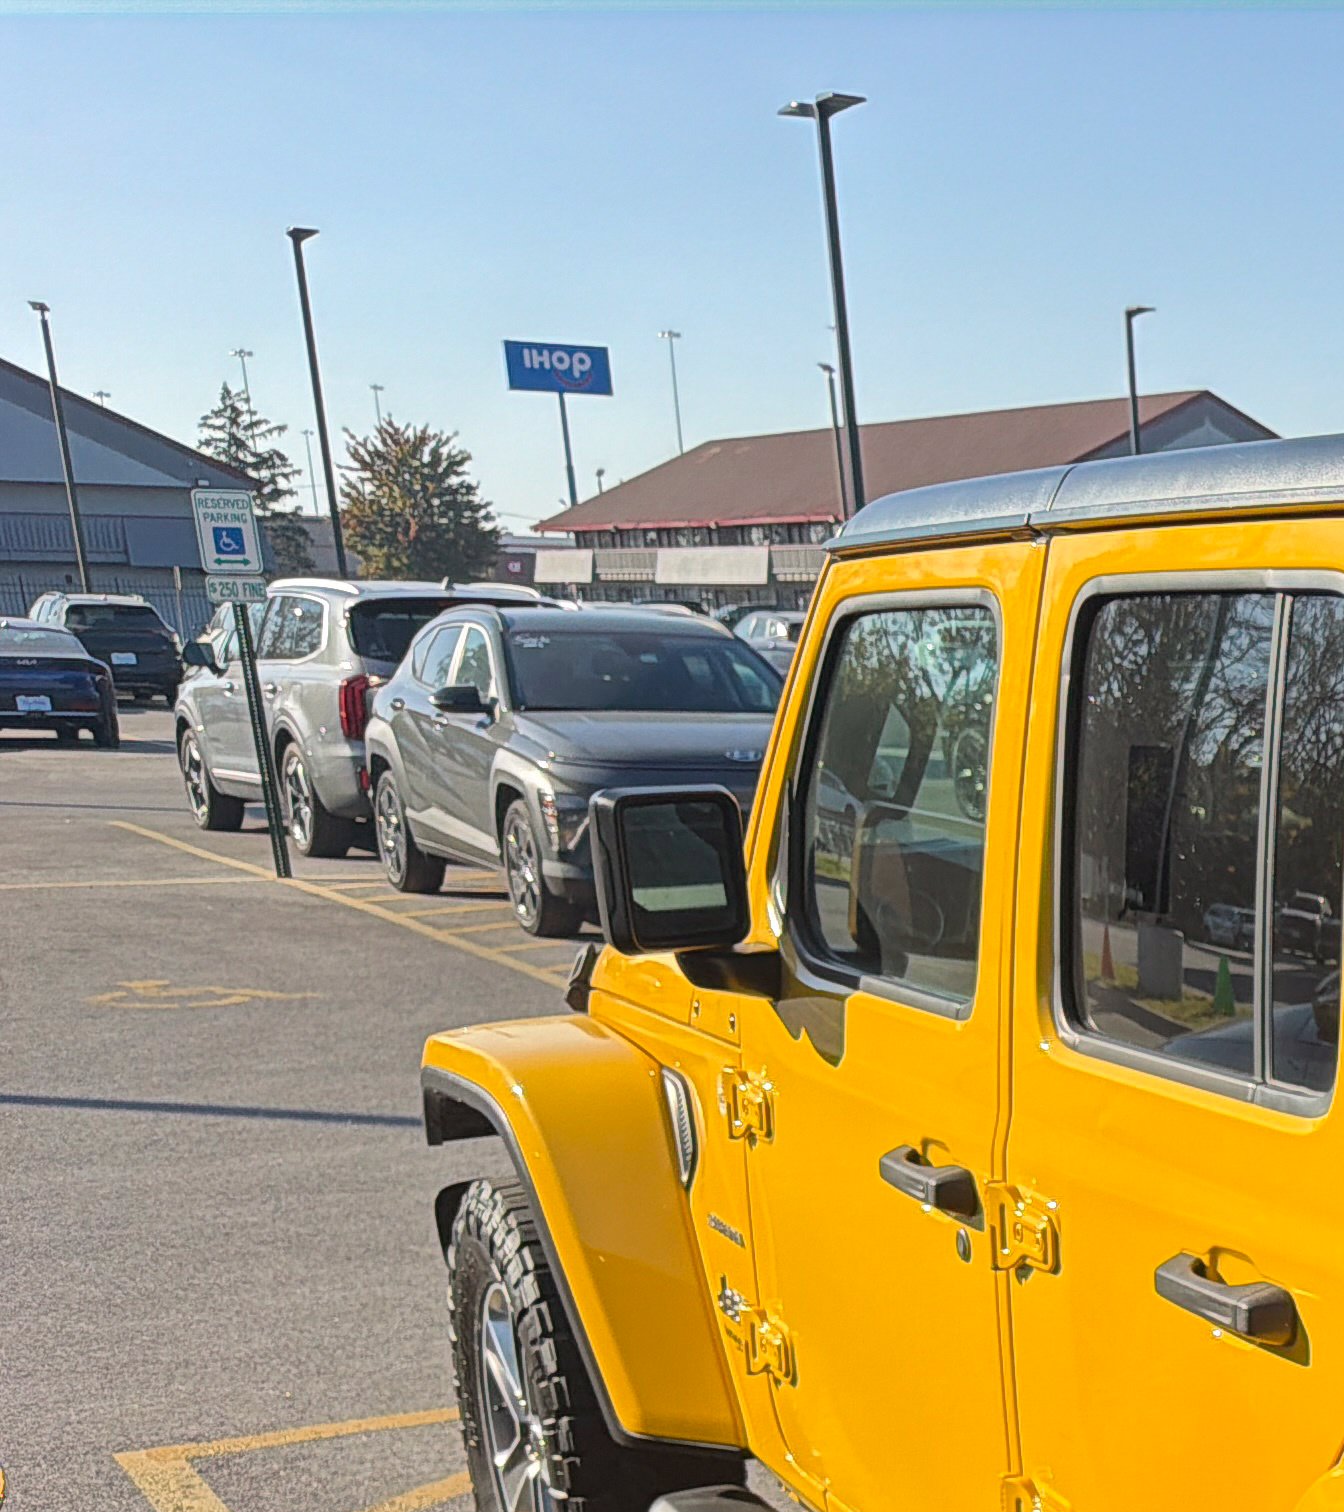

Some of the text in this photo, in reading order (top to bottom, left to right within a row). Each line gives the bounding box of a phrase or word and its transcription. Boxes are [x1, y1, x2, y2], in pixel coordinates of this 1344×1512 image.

[197, 497, 249, 510] RESERVED
[202, 512, 248, 524] PARKING
[242, 582, 266, 598] FINE
